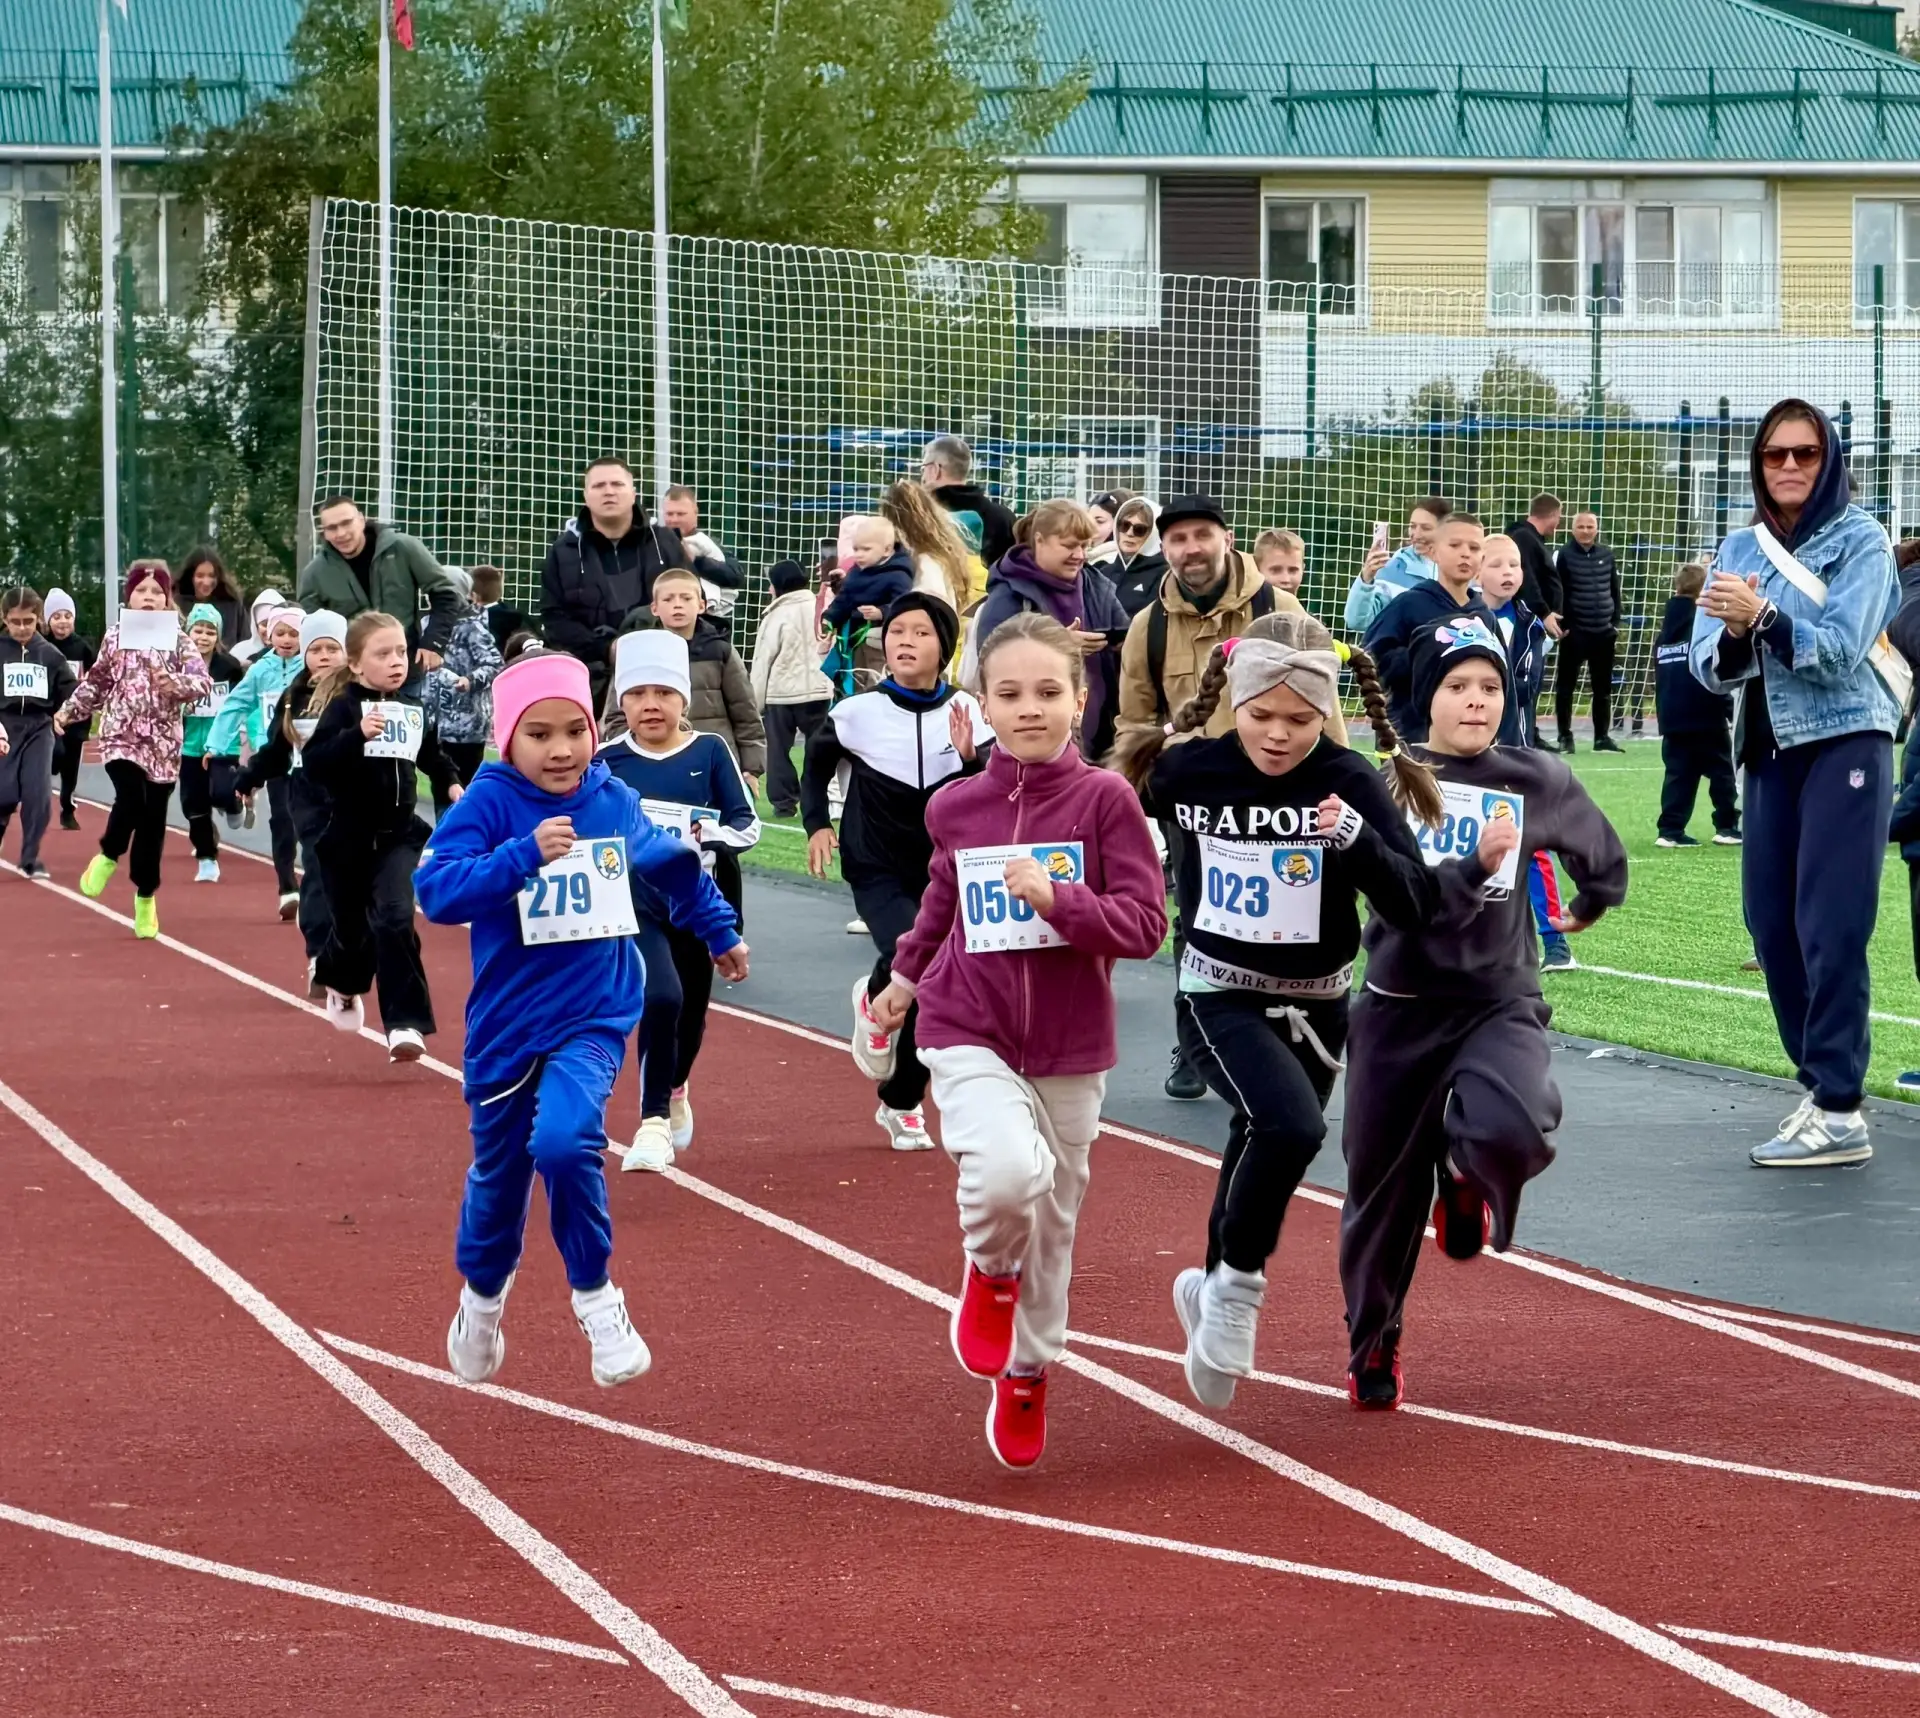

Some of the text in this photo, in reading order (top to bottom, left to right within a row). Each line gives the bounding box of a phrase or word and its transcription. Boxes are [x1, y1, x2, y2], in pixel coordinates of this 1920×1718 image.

[7, 673, 34, 688] 200
[370, 719, 407, 744] 96
[1175, 803, 1211, 834] BE
[1214, 806, 1241, 835] A
[525, 872, 592, 919] 279
[1208, 866, 1270, 918] 023
[1276, 980, 1315, 990] FOR
